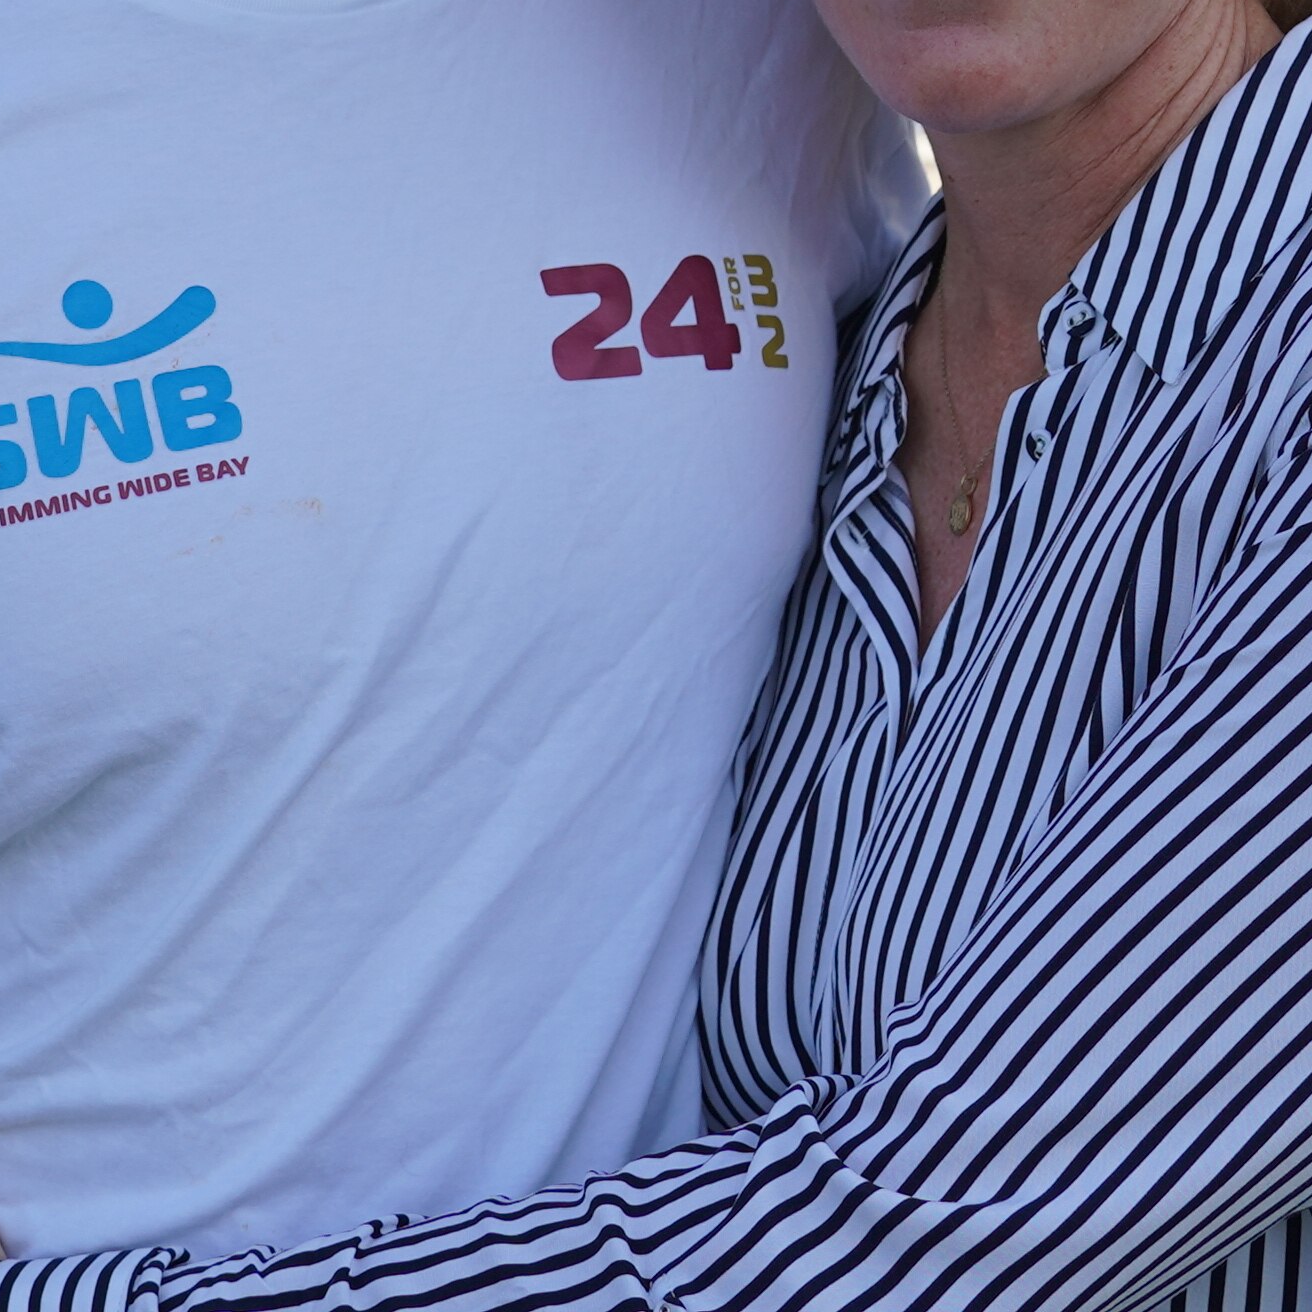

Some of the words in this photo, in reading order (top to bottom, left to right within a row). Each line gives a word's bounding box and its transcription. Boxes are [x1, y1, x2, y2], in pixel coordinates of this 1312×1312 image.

[540, 255, 741, 381] 24
[723, 257, 745, 311] FOR
[117, 468, 192, 500] WIDE
[196, 456, 250, 483] BAY
